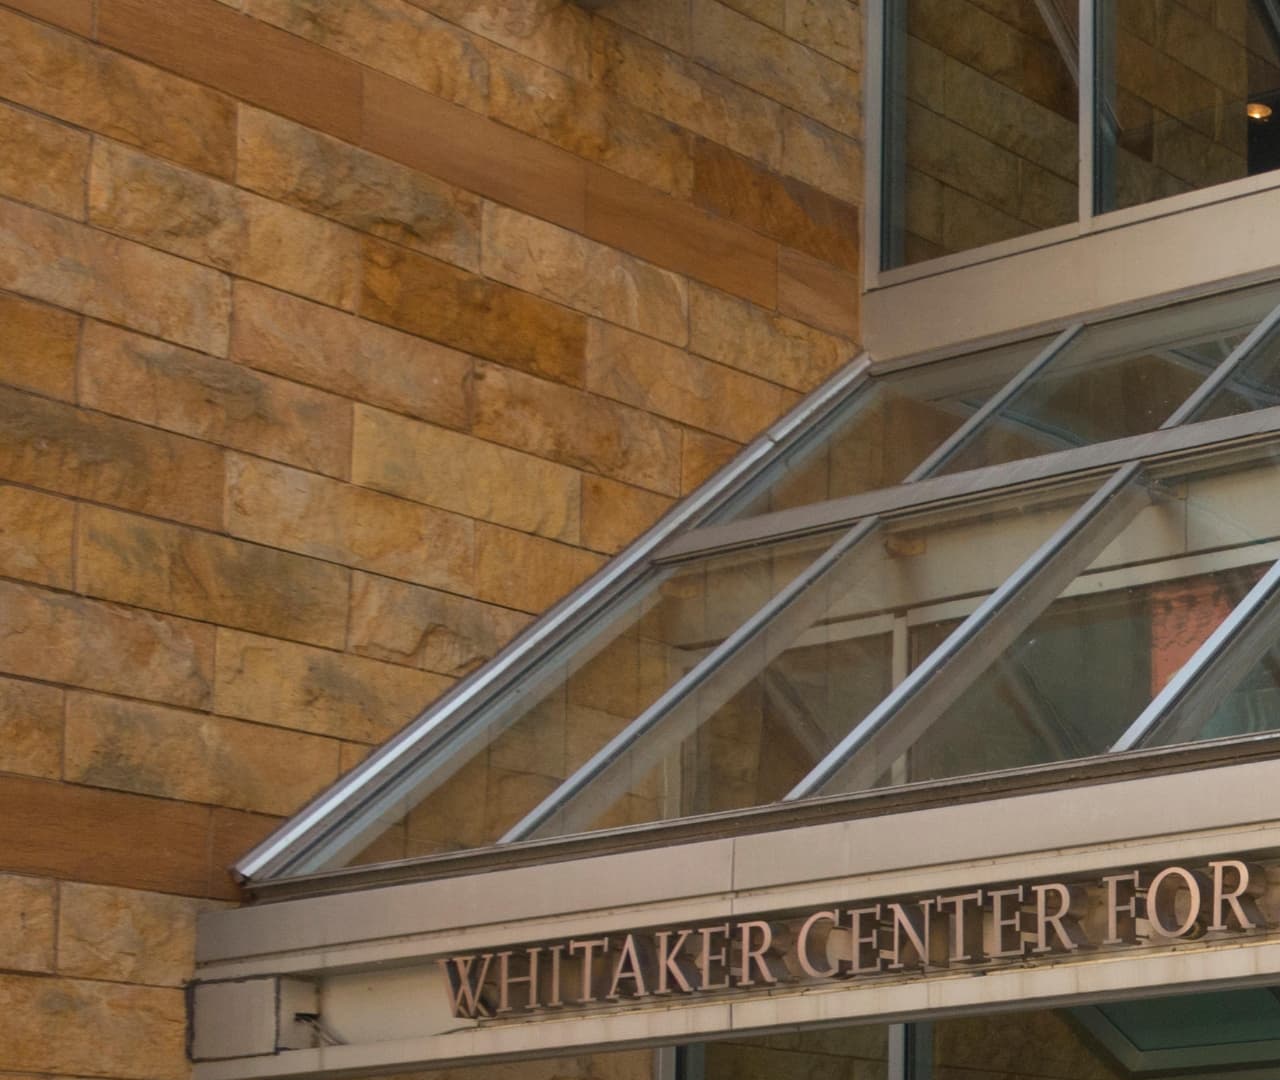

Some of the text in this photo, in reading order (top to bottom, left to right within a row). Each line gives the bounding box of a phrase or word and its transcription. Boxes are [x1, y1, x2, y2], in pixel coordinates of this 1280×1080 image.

[437, 921, 778, 1018] WHITAKER
[798, 882, 1079, 978] CENTER
[1102, 859, 1257, 945] FOR
